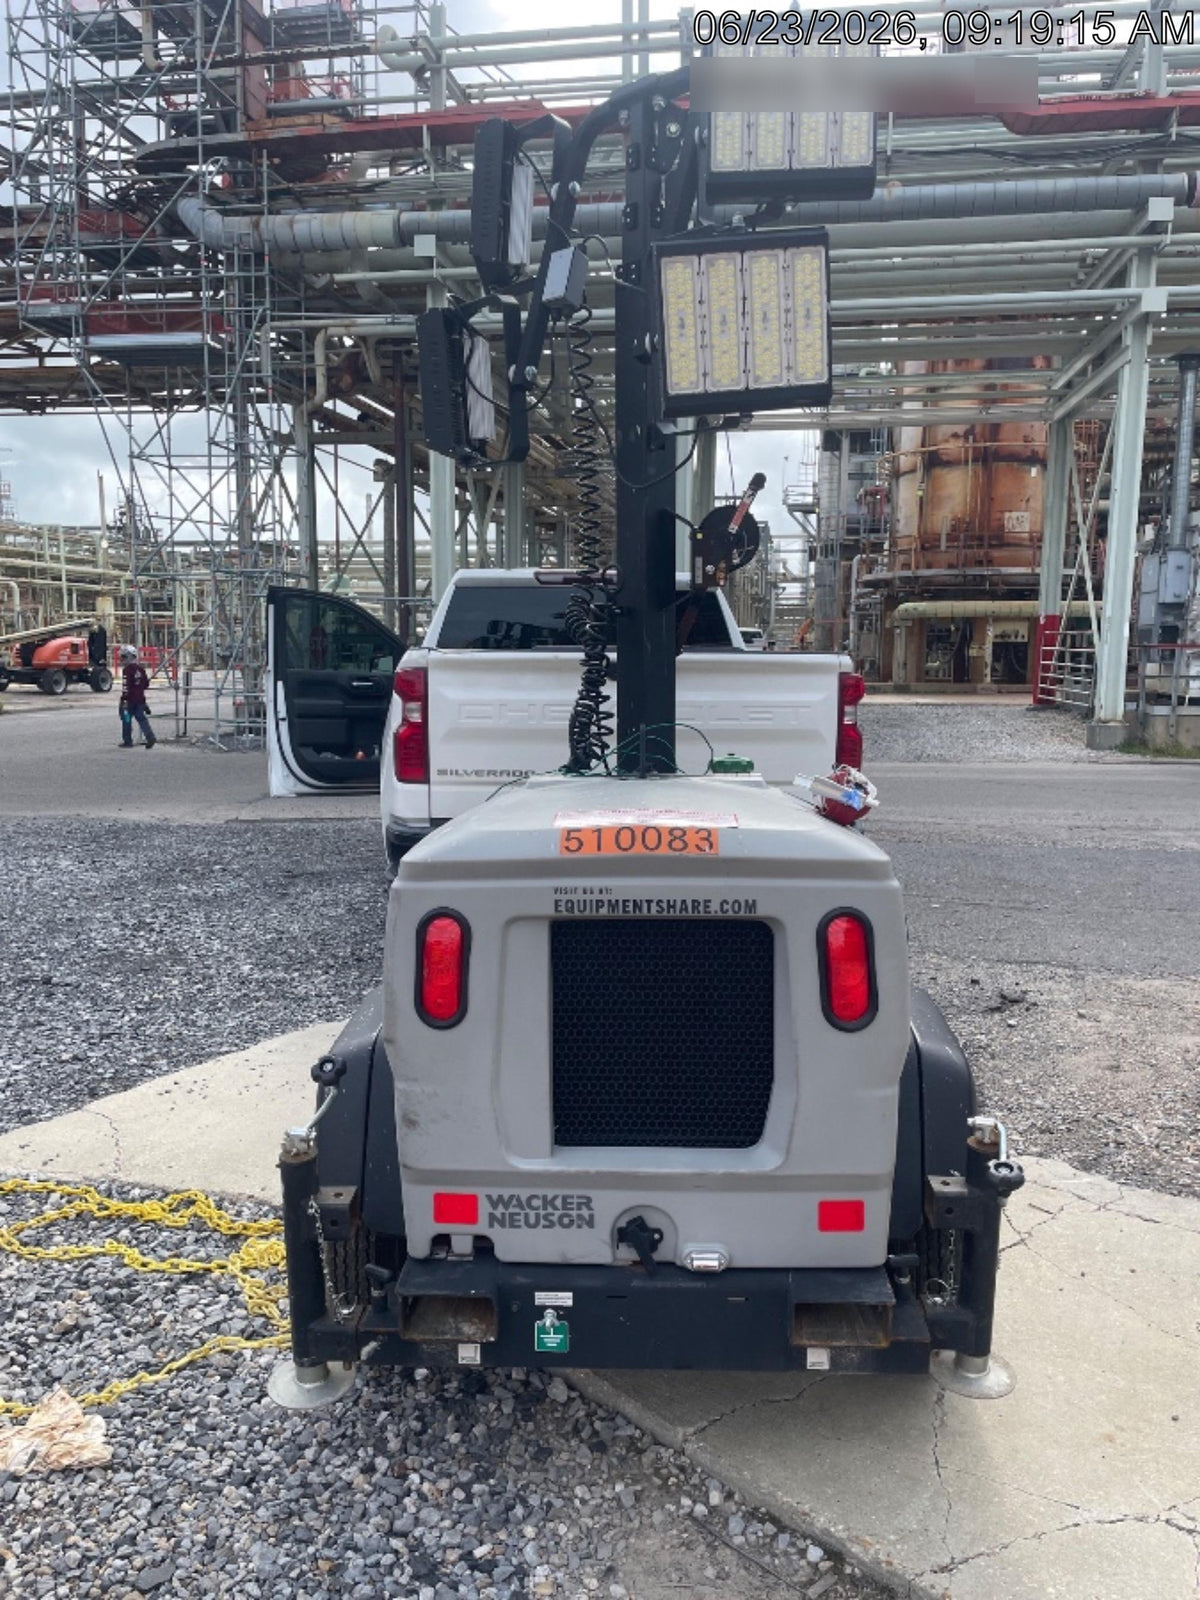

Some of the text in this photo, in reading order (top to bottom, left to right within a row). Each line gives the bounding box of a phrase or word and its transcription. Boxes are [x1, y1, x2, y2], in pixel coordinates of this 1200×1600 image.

[563, 826, 714, 853] 510083
[554, 898, 758, 915] EQUIPMENTSHARE.COM
[485, 1193, 594, 1212] WACKER
[487, 1211, 595, 1230] NEUSON
